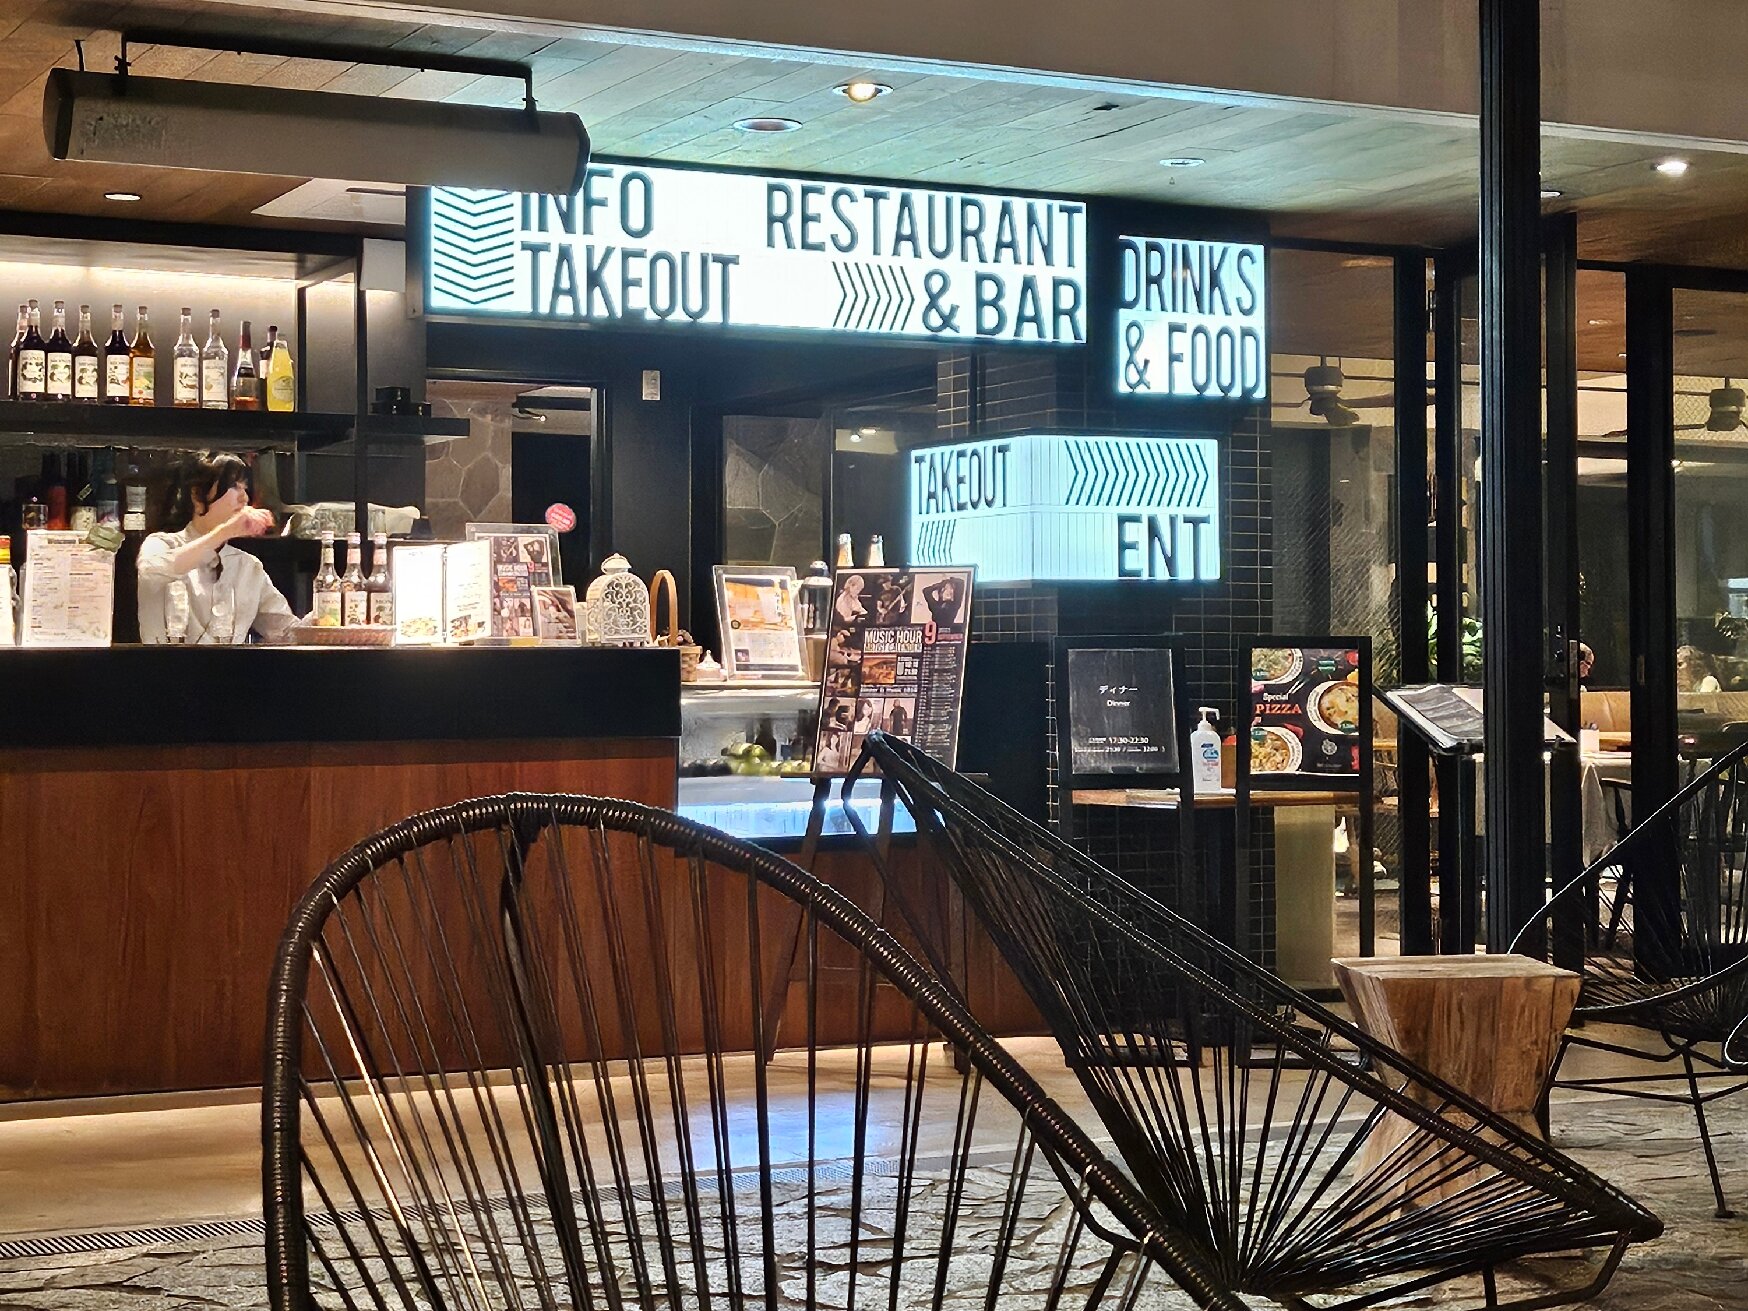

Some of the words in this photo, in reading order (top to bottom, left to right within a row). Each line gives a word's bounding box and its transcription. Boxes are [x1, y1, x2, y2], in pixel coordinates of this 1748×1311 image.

[520, 168, 654, 238] INFO
[766, 180, 1084, 268] RESTAURANT
[520, 241, 740, 324] TAKEOUT
[922, 268, 960, 333] &
[975, 270, 1083, 341] BAR
[1120, 238, 1257, 317] DRINKS
[1125, 320, 1150, 391] &
[1167, 322, 1262, 397] FOOD
[914, 444, 1011, 515] TAKEOUT
[1117, 514, 1211, 579] ENT
[864, 630, 895, 644] MUSIC
[896, 630, 923, 644] HOUR
[924, 621, 937, 645] 9
[1099, 685, 1138, 694] ディナー
[1107, 699, 1131, 707] Dinner
[1255, 703, 1302, 714] PIZZA
[1262, 692, 1289, 702] Special
